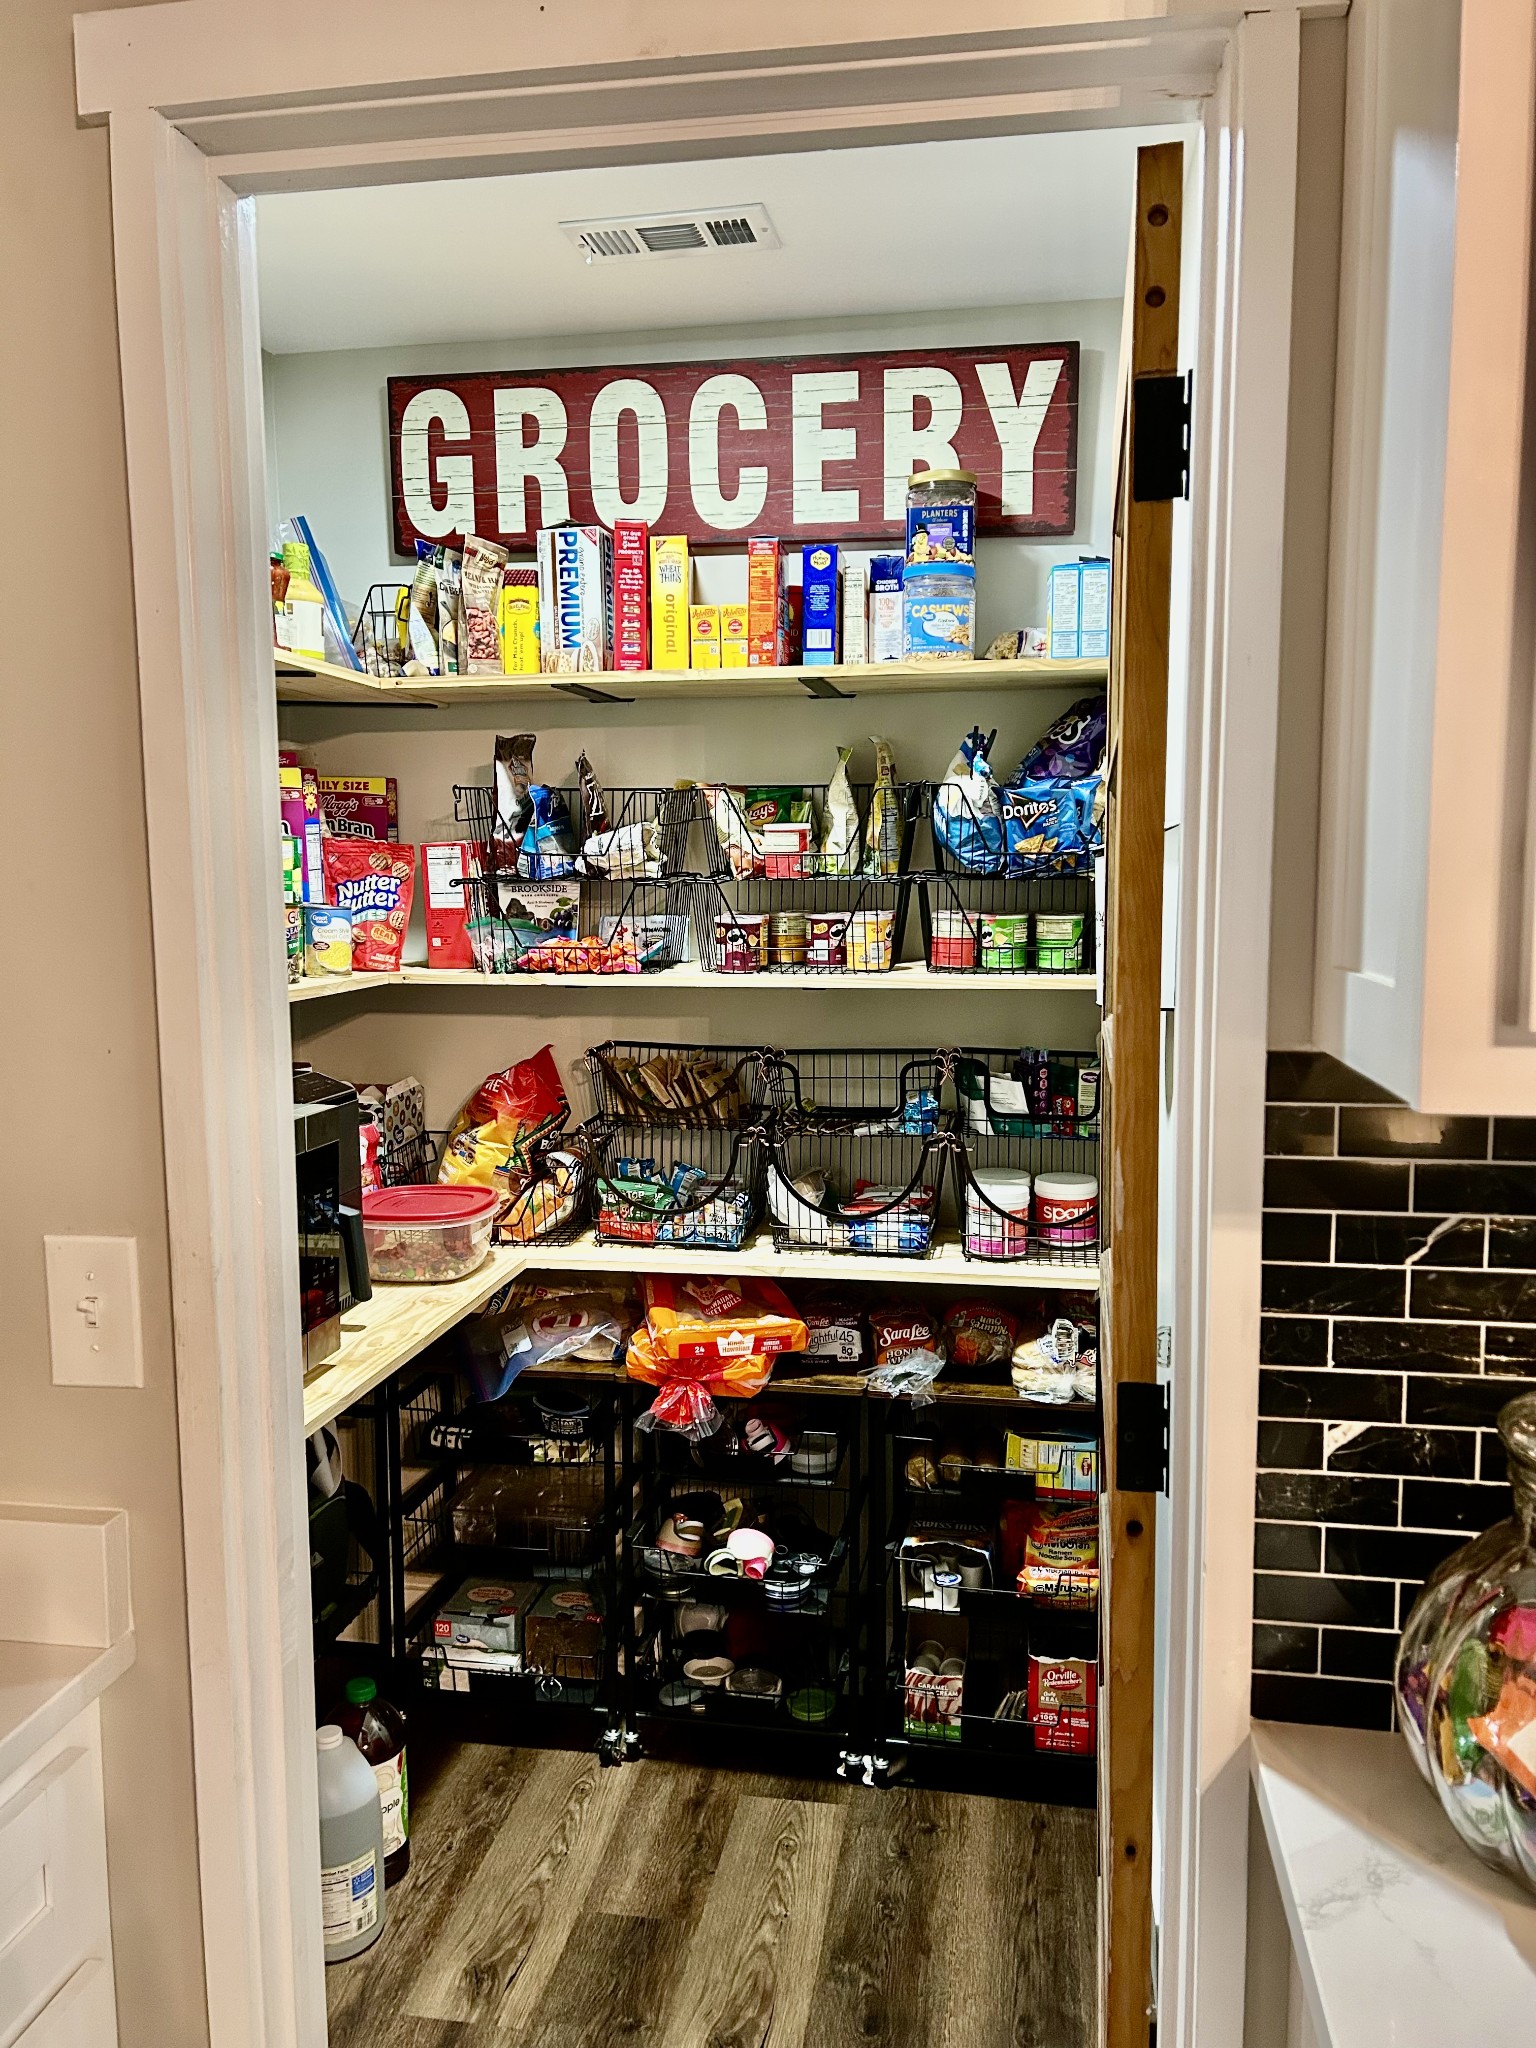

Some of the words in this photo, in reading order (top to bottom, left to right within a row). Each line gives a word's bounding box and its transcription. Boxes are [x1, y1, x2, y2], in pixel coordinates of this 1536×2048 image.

[402, 360, 1064, 539] GROCERY
[921, 509, 958, 519] PLANTERS
[659, 565, 682, 573] WHEAT
[659, 573, 682, 584] THINS
[558, 531, 582, 649] PREMIUM
[875, 583, 899, 592] BROTH
[911, 604, 969, 618] CASHEWS
[663, 593, 678, 655] original
[342, 781, 370, 791] SIZE
[747, 802, 775, 820] Lay's
[1001, 799, 1057, 821] Doritos
[337, 819, 374, 839] Bran
[338, 874, 401, 901] Nutter
[511, 885, 568, 893] BROOKSIDE
[352, 908, 388, 925] ITES
[373, 927, 394, 941] REAL
[1043, 1201, 1094, 1223] spark
[839, 1330, 855, 1343] 45
[879, 1327, 911, 1347] Sara
[909, 1323, 932, 1342] Lee
[694, 1345, 705, 1354] 24
[841, 1345, 854, 1357] 8g
[1038, 1551, 1063, 1561] Noodle
[1063, 1554, 1082, 1563] Soup
[1048, 1548, 1073, 1556] Ramen
[435, 1623, 450, 1633] 120
[1046, 1670, 1077, 1681] Orville
[917, 1682, 949, 1691] CARAMEL
[381, 1798, 401, 1814] pple
